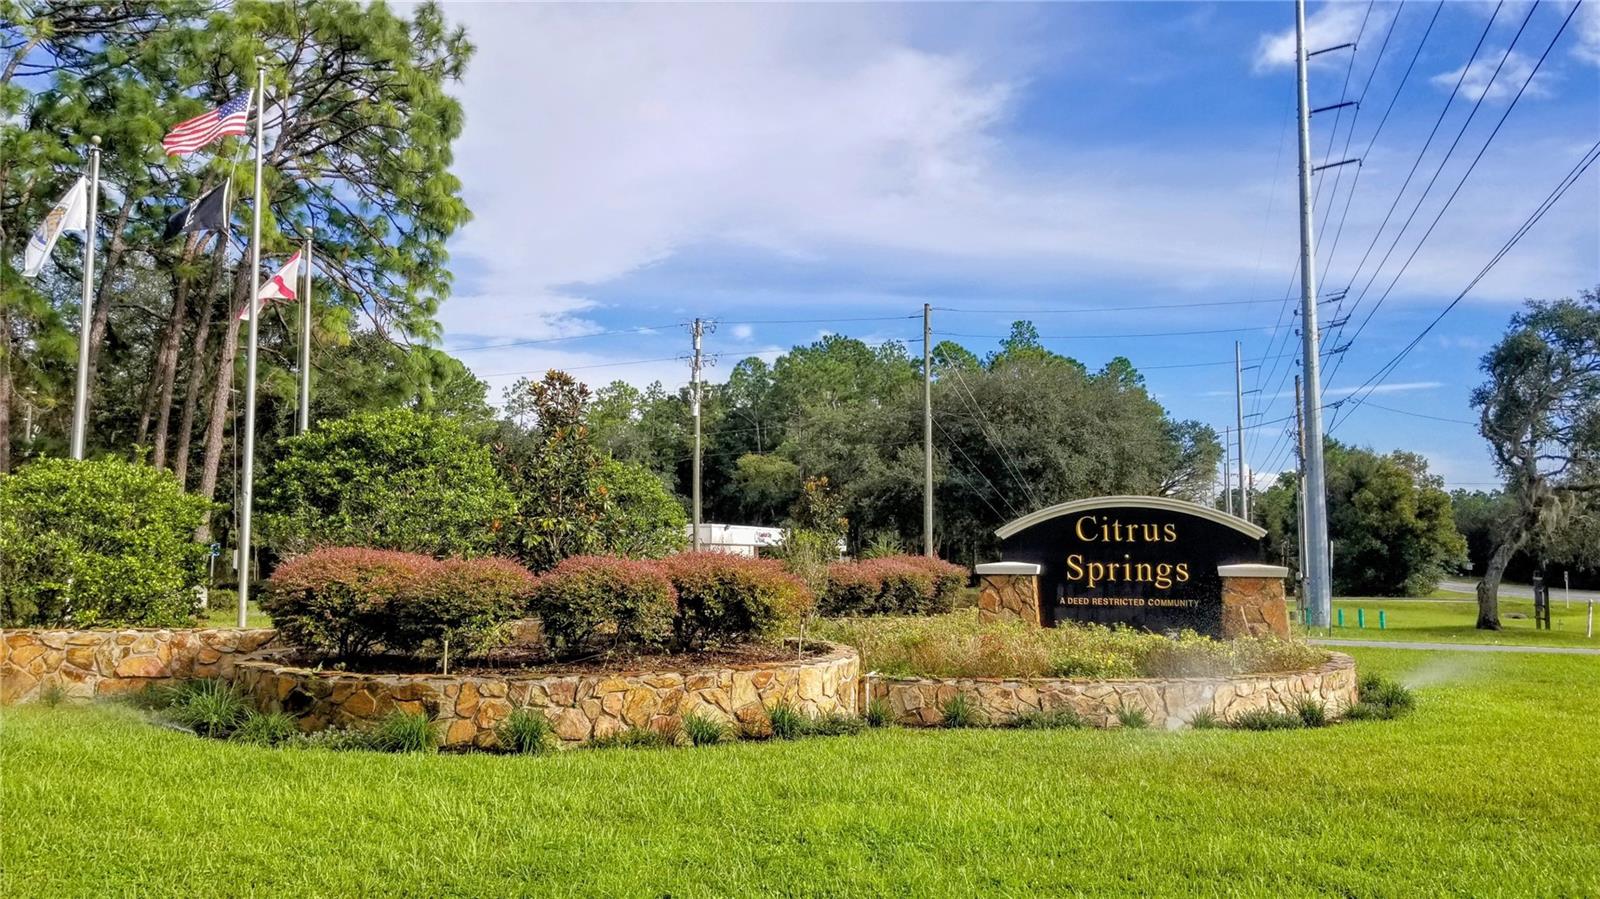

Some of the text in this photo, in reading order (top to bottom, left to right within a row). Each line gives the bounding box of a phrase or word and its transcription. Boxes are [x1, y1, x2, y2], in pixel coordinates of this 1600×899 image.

[1075, 515, 1177, 542] Citrus
[1066, 554, 1190, 589] Springs
[1060, 597, 1200, 608] A DEED RESTRICTED COMMUNITY
